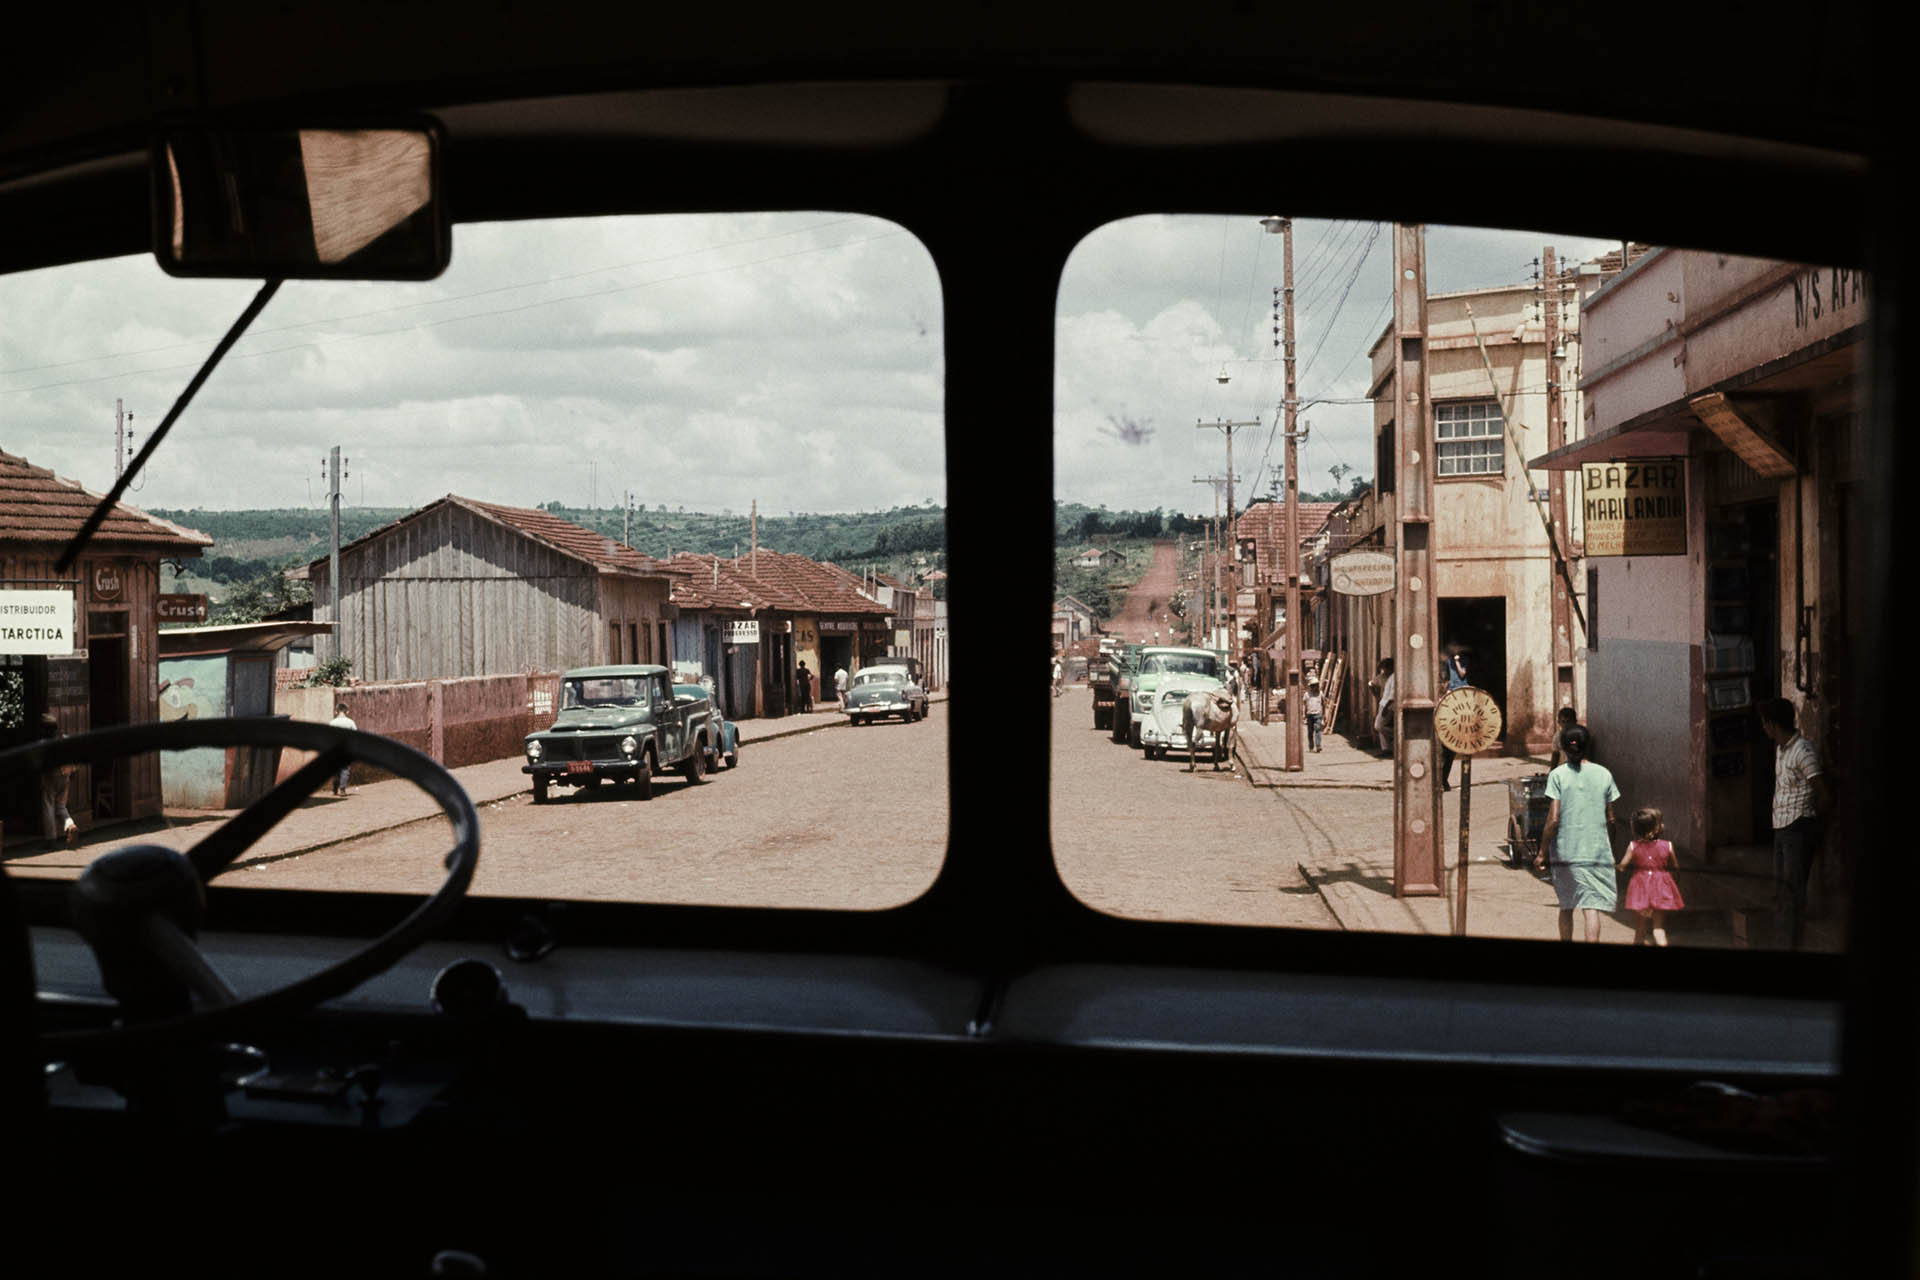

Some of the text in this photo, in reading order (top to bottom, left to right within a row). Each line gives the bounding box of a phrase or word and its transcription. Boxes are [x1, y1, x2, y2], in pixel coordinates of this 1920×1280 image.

[1586, 466, 1678, 491] BAZAR
[1586, 496, 1682, 520] MARILANDIA
[96, 567, 120, 592] Crush
[157, 600, 205, 617] Crush
[1, 628, 63, 640] TARCTICA
[724, 622, 757, 630] BAZAR
